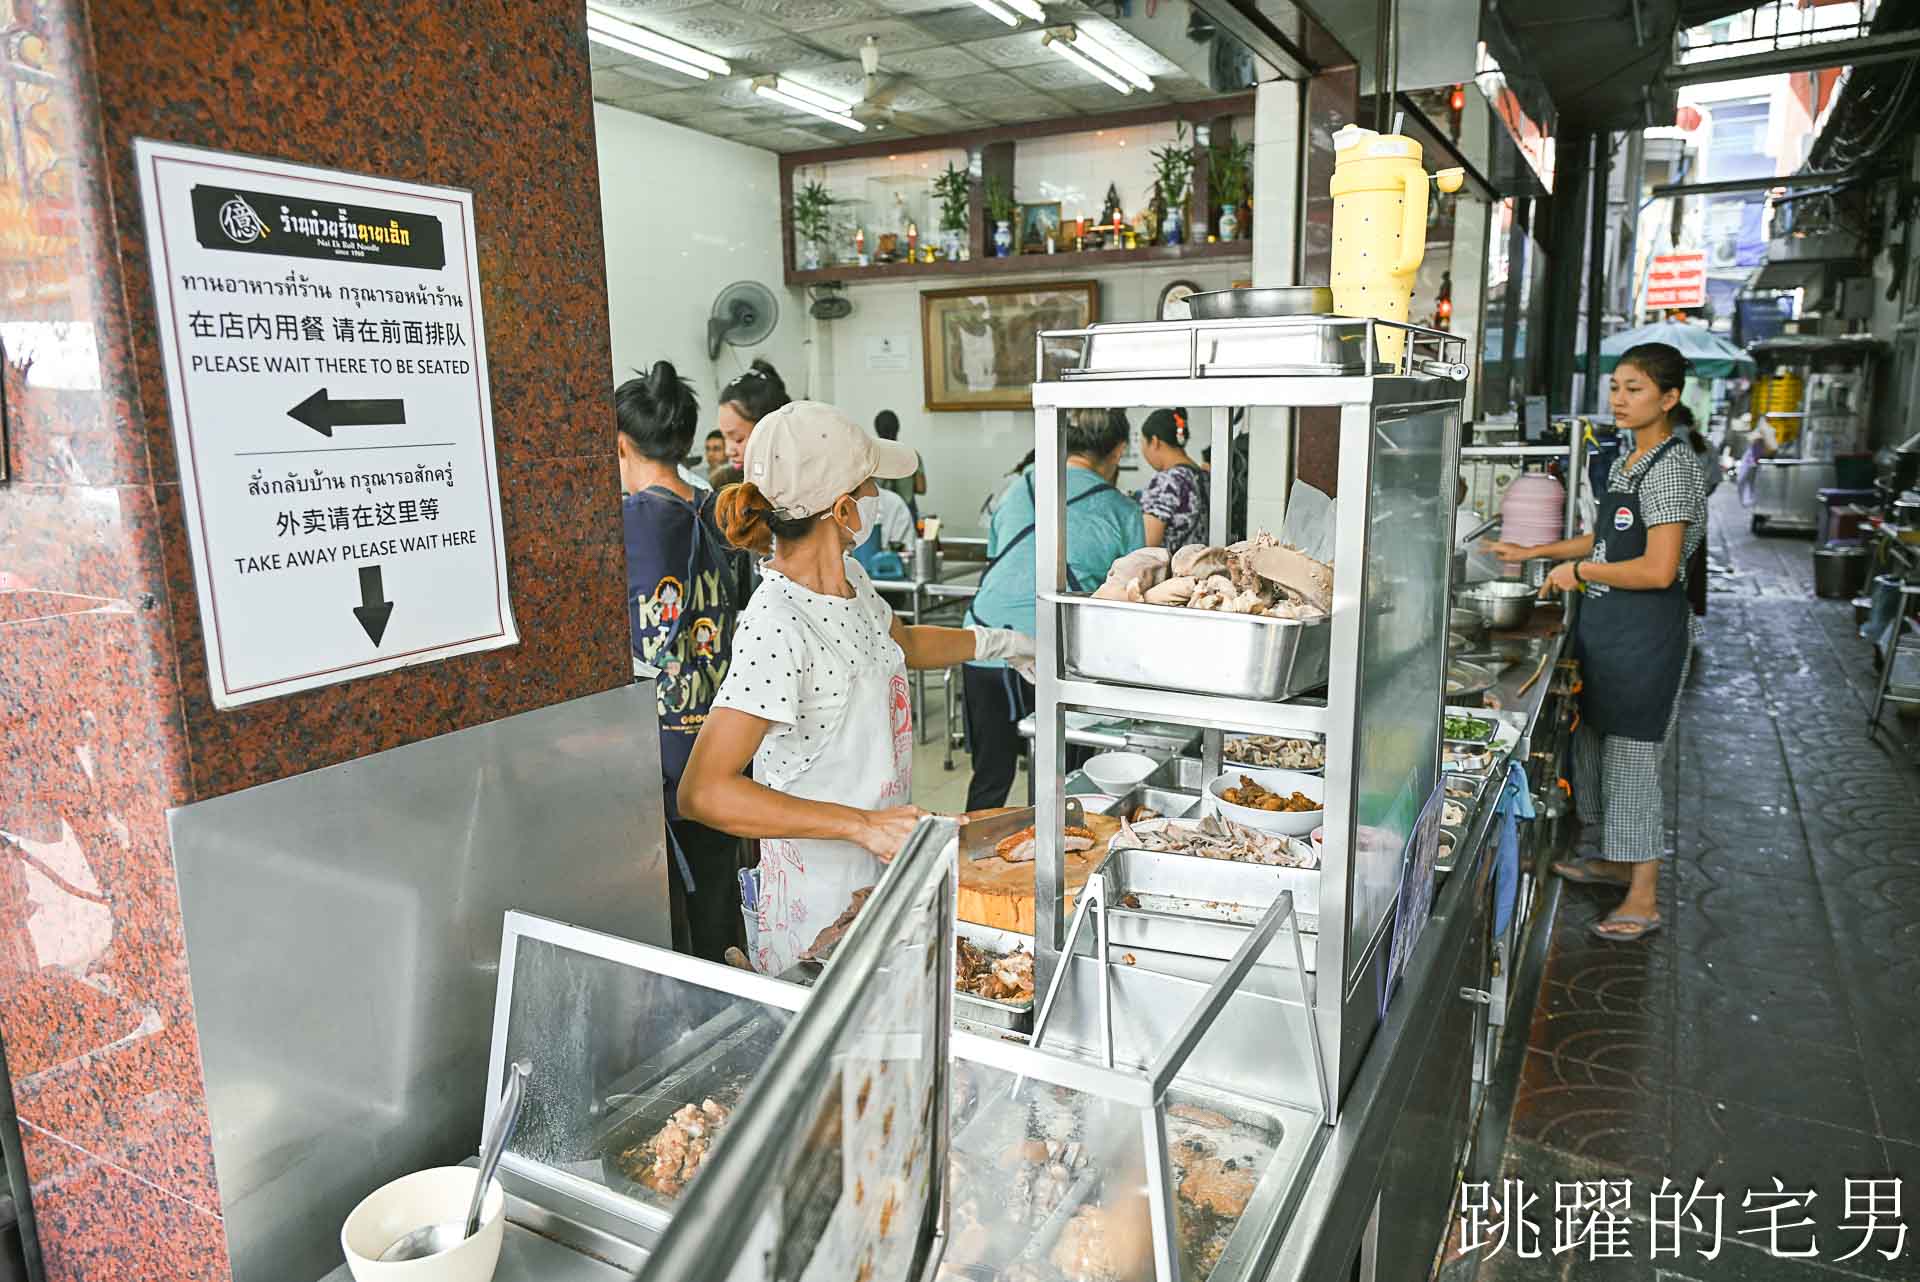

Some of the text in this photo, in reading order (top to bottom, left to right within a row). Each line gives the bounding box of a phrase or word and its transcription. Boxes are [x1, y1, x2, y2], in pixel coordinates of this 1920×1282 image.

[181, 269, 463, 309] ทานอาหารที่ร้าน กรุณารอหน้าร้าน
[188, 310, 466, 346] 在店内用餐 请在前面排队
[192, 355, 470, 375] PLEASE WAIT THERE TO BE SEATED
[248, 461, 454, 496] สั่งกลับบ้าน กรุณารอสักครู่
[276, 497, 440, 537] 外卖请在这里等
[234, 529, 477, 574] TAKE AWAY PLEASE WAIT HERE
